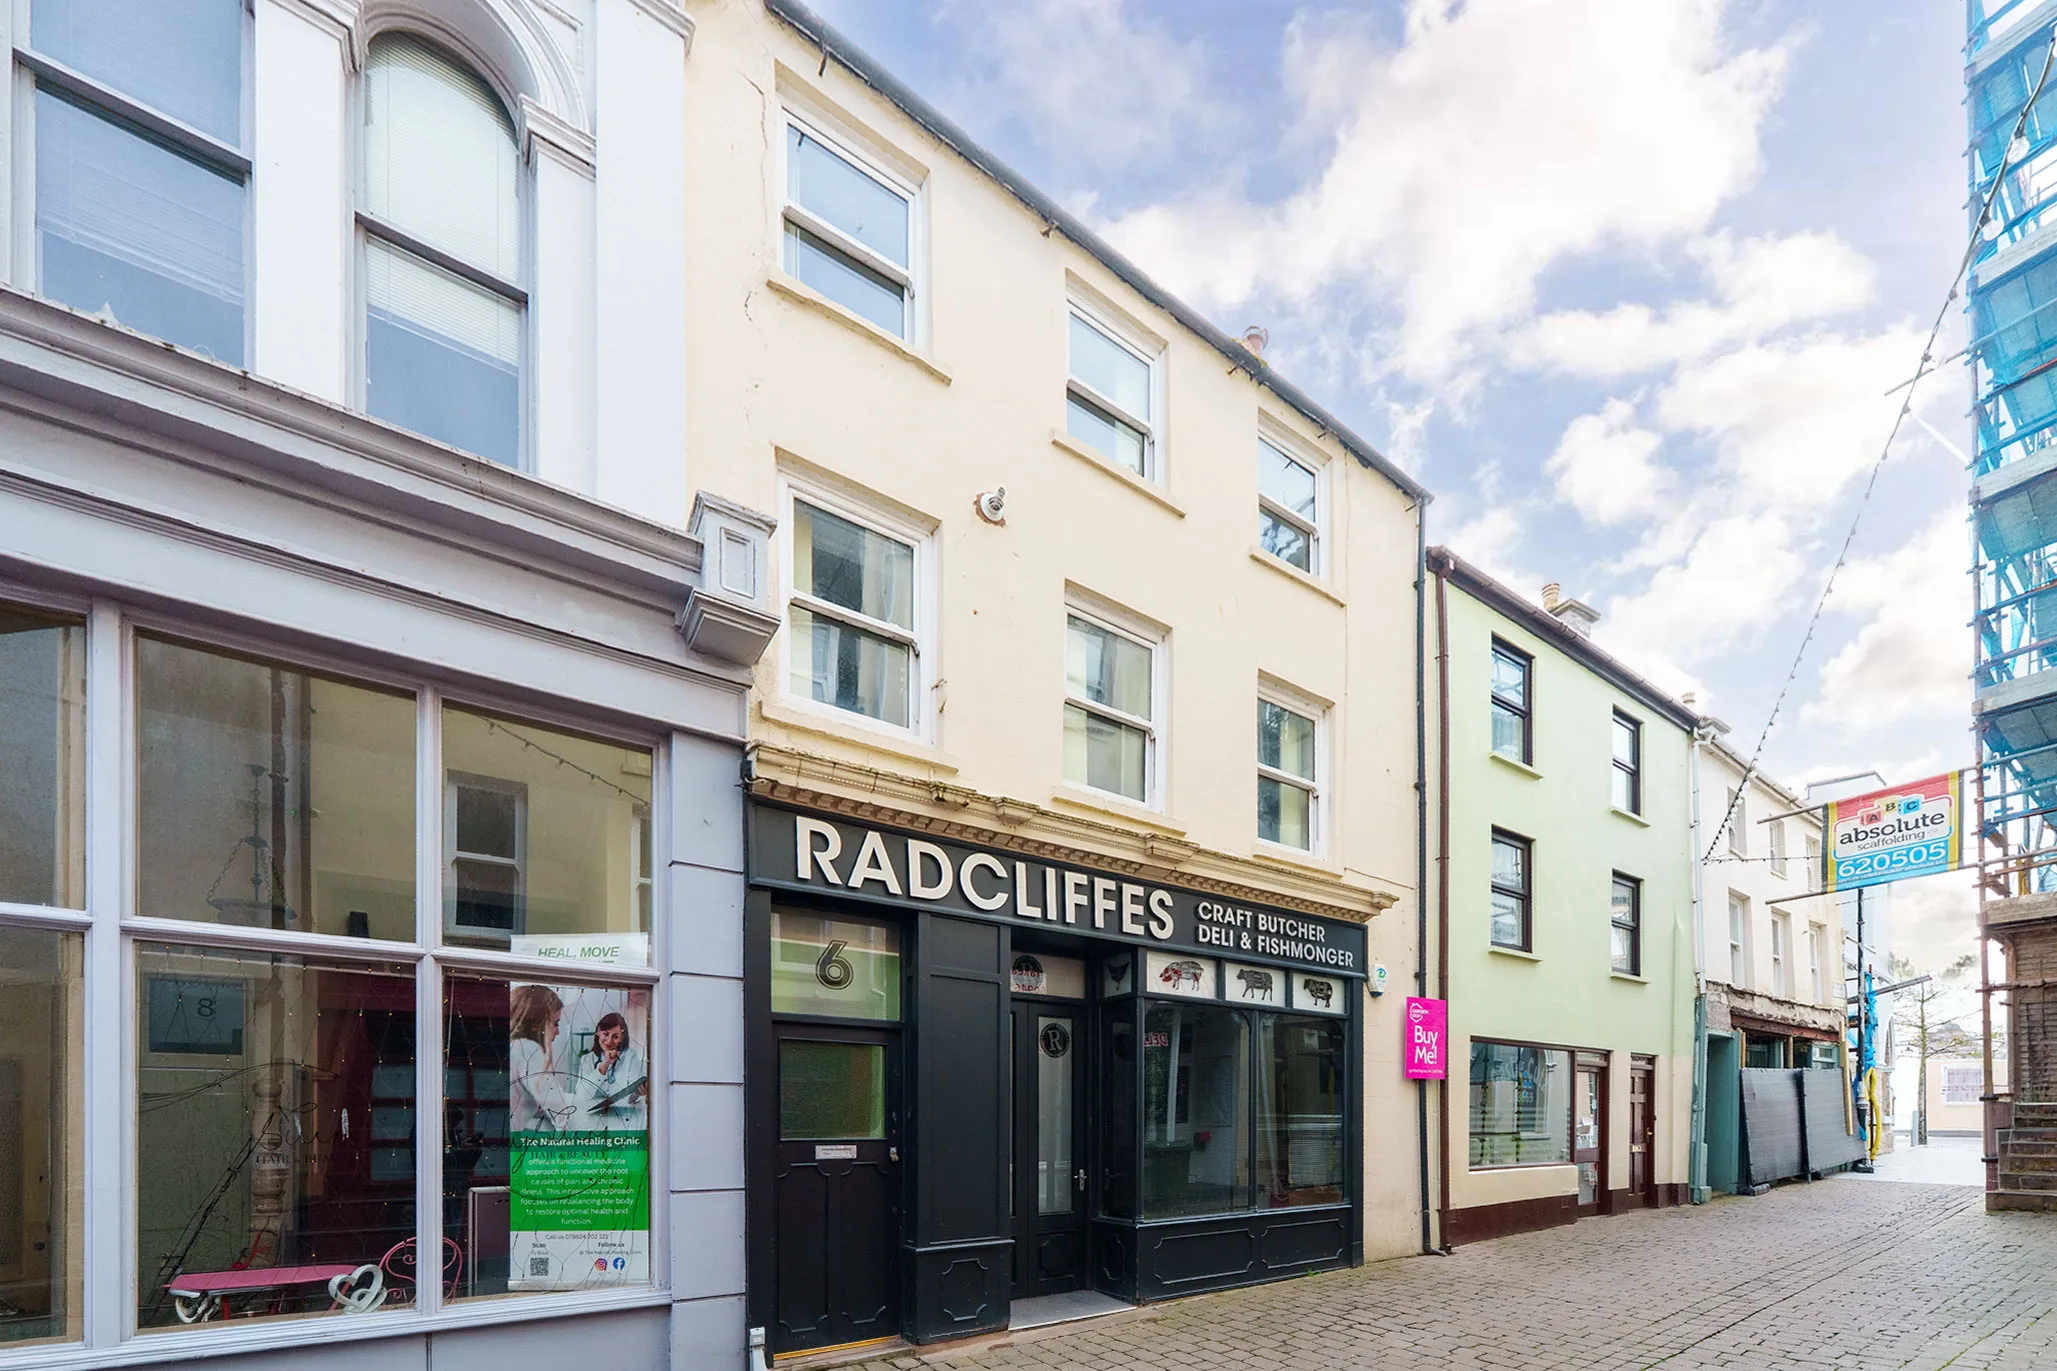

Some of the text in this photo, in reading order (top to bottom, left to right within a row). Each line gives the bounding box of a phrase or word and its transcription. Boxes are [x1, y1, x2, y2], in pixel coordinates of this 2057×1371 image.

[1869, 800, 1918, 822] A B C
[1839, 812, 1945, 845] absolute
[1857, 831, 1925, 851] scaffolding
[1838, 844, 1946, 877] 620505
[795, 815, 1174, 941] RADCLIFFES
[1197, 901, 1327, 944] CRAFT BUTCHER
[538, 946, 620, 959] HEAL, MOVE
[1197, 924, 1354, 968] DELI & FISHMONGER
[816, 939, 854, 990] 6
[198, 998, 214, 1017] 8
[1047, 1029, 1063, 1050] R
[1414, 1025, 1438, 1049] Buy
[1414, 1046, 1437, 1065] Me!
[540, 1138, 575, 1146] Natural
[577, 1137, 613, 1147] Healing
[614, 1137, 640, 1146] Clinic
[530, 1150, 557, 1158] HAIR
[566, 1150, 606, 1158] BEAUTY
[525, 1168, 560, 1176] approach
[600, 1187, 634, 1196] approach
[616, 1198, 633, 1206] body
